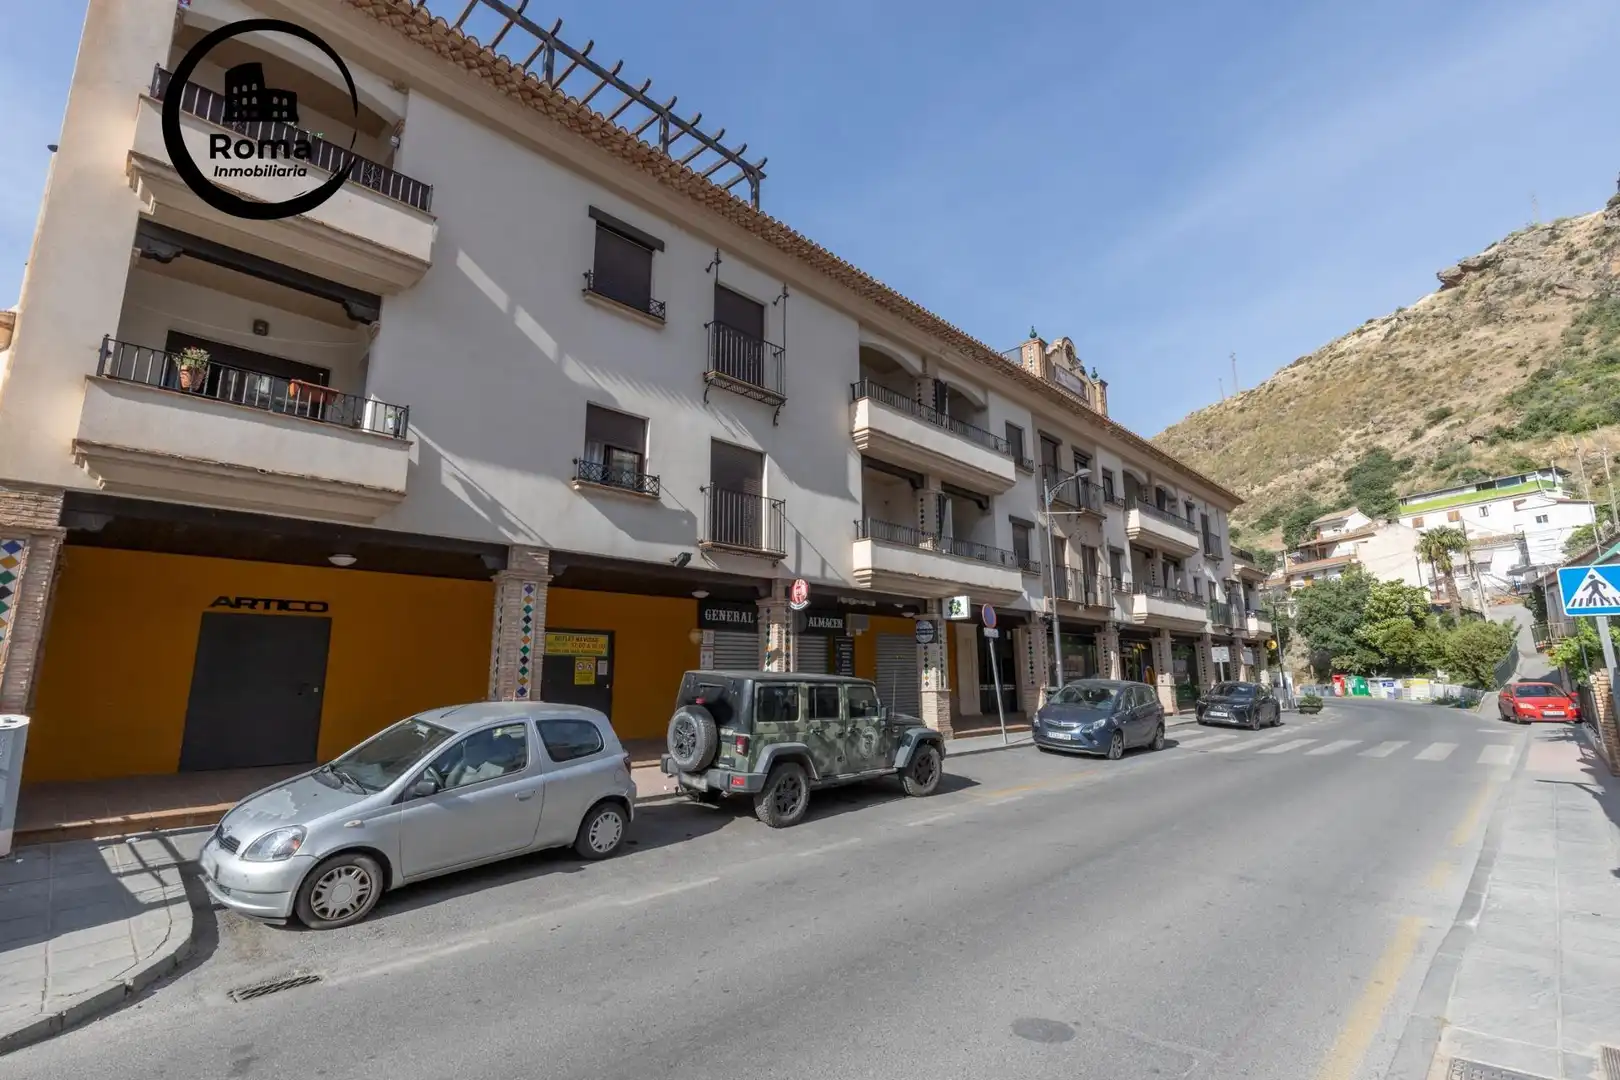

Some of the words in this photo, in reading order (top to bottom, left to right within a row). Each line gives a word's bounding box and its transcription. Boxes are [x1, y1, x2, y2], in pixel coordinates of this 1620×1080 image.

[209, 596, 328, 612] ARTICO
[704, 609, 754, 624] GENERAL
[808, 616, 843, 628] ALMACEN
